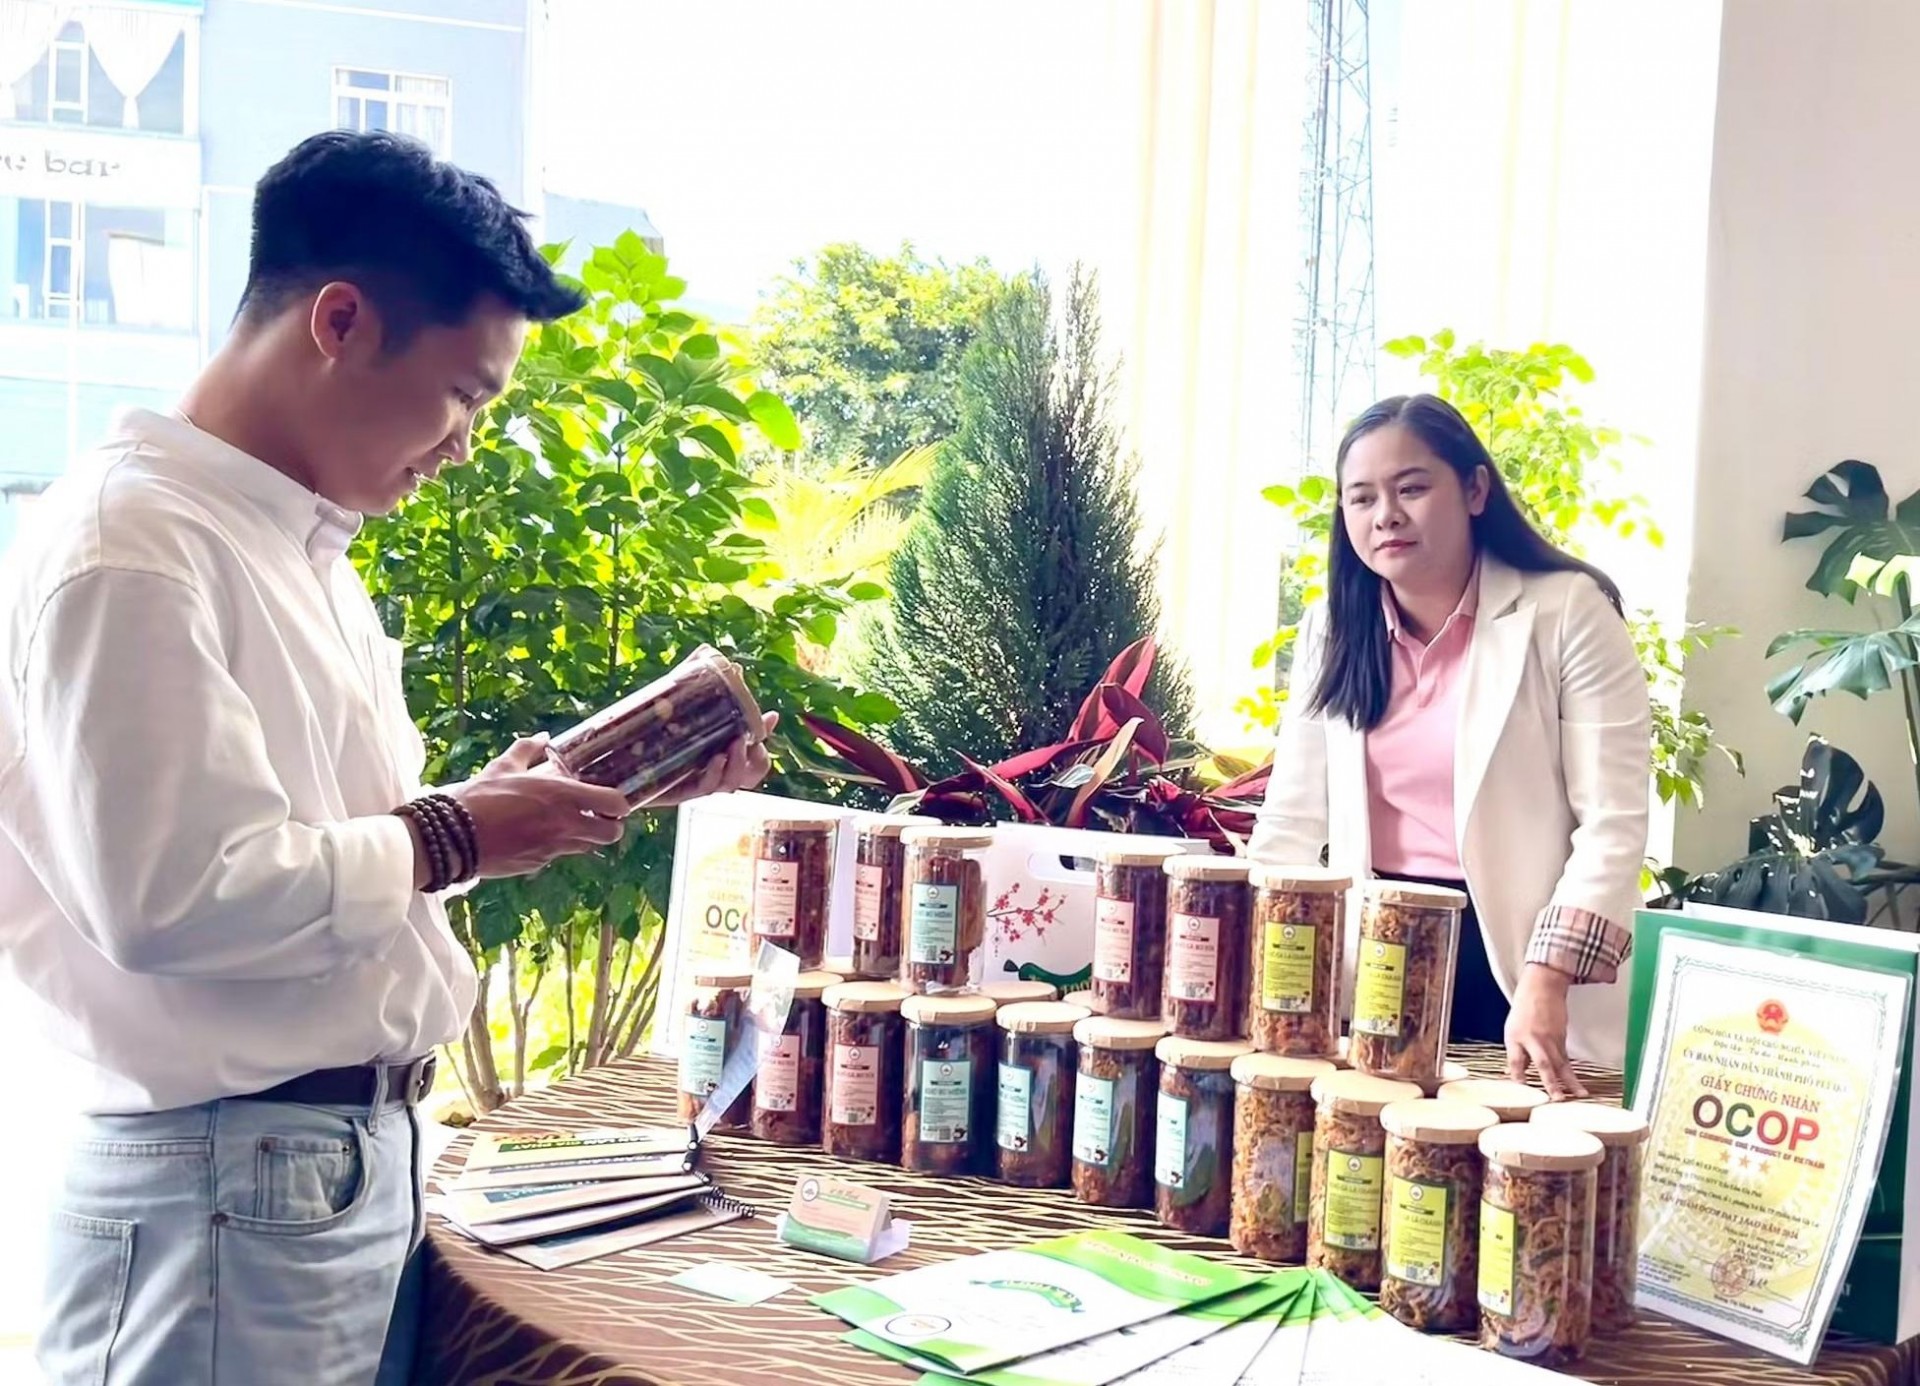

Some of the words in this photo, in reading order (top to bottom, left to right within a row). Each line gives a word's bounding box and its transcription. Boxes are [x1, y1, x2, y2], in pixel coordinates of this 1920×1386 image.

[44, 149, 120, 177] bar
[706, 904, 748, 933] OC
[1692, 1094, 1820, 1151] OCOP
